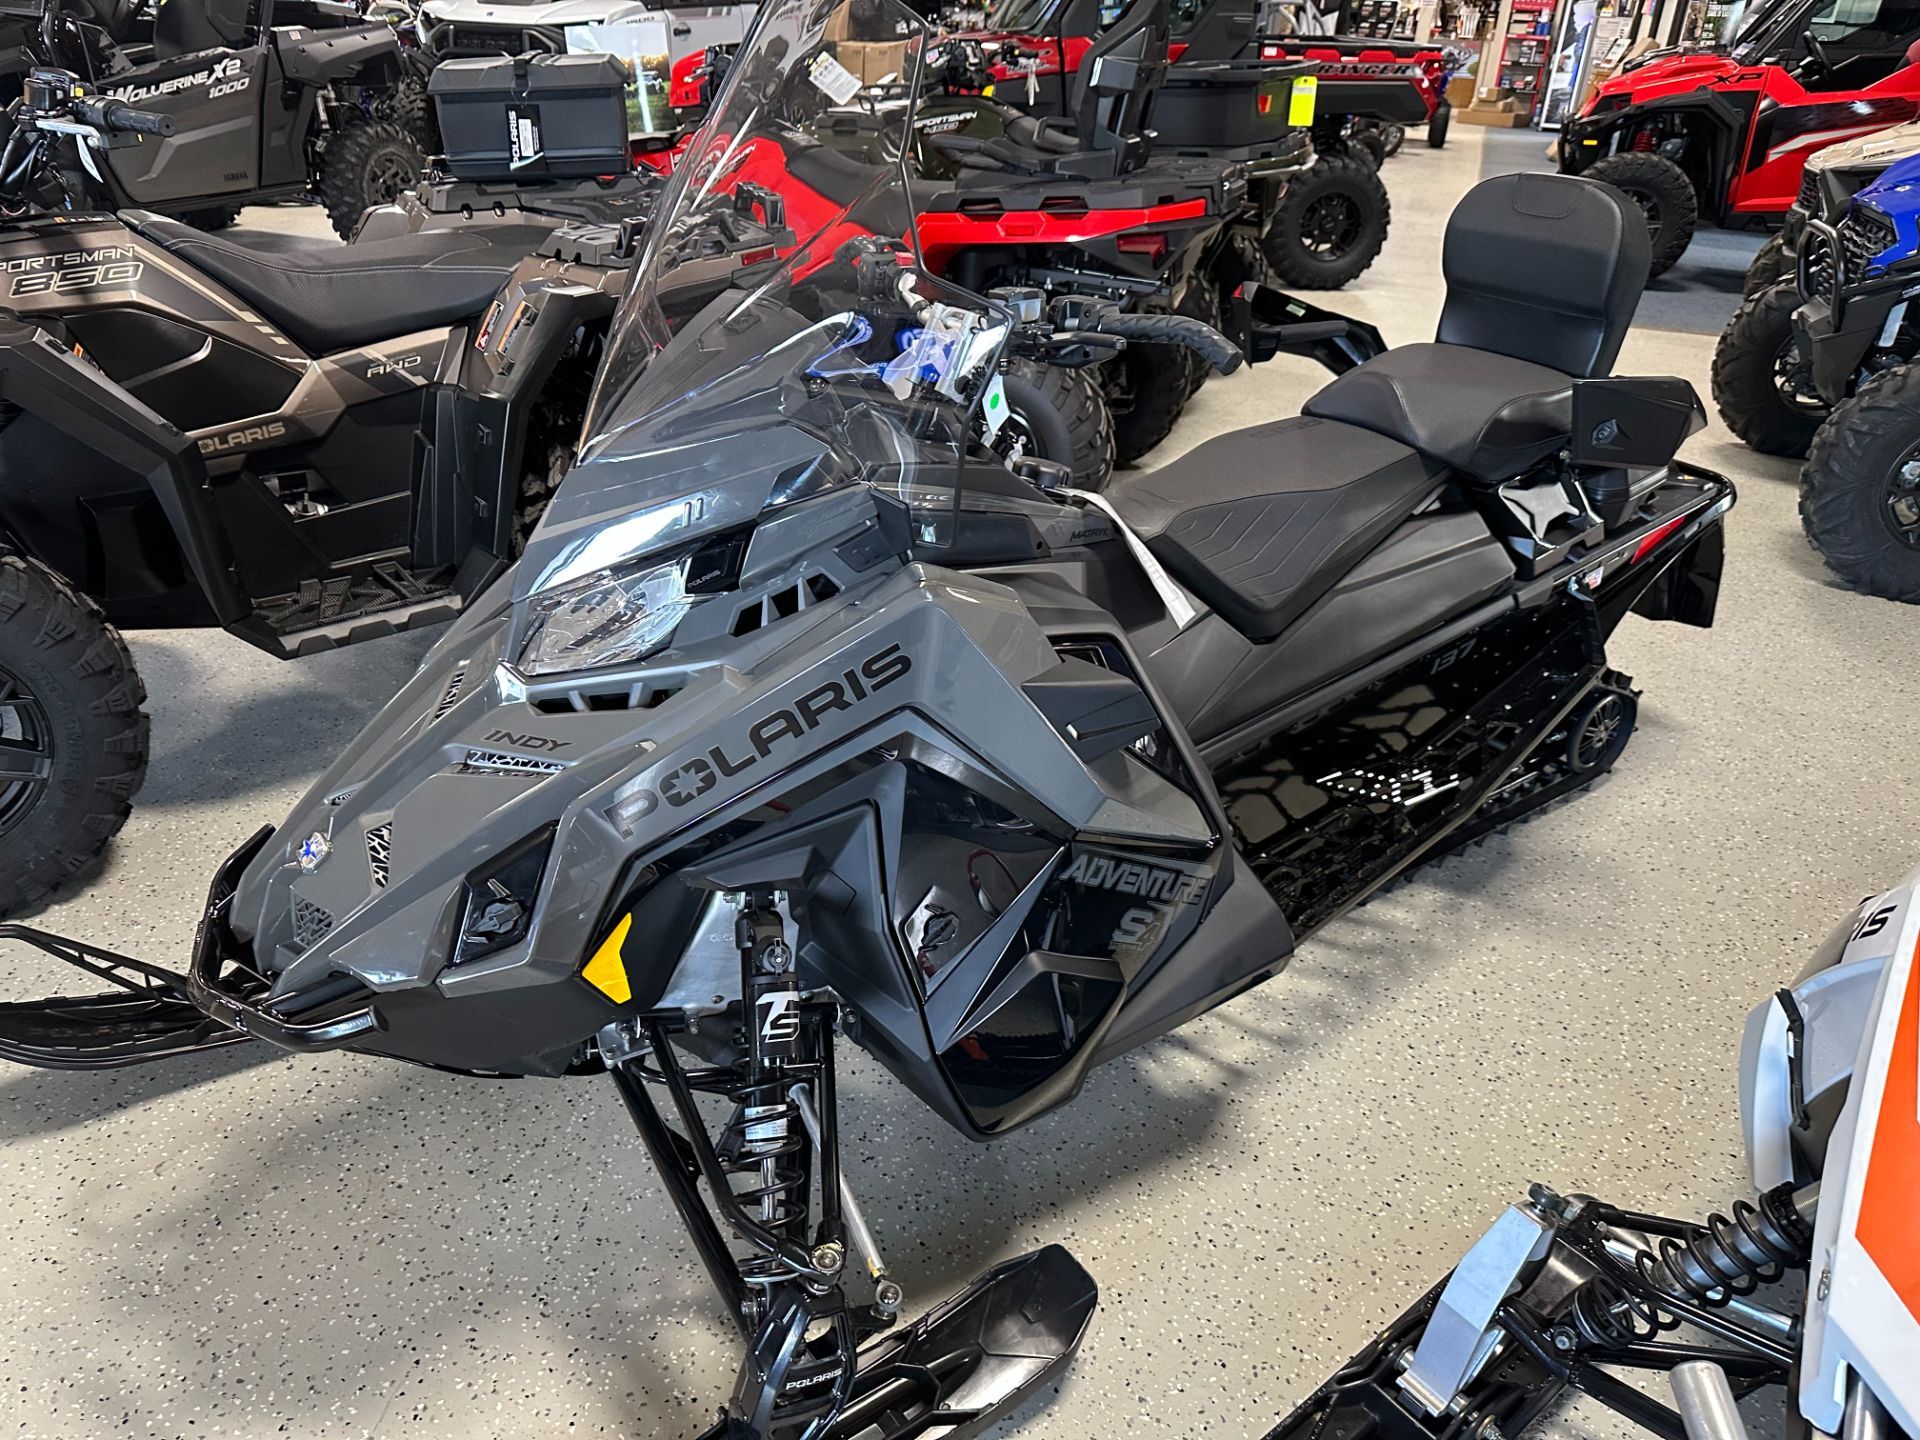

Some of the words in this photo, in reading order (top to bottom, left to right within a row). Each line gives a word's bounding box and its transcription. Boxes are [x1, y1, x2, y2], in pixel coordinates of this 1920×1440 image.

[106, 71, 209, 102] WOLVERINE
[206, 58, 241, 85] X2
[1316, 63, 1412, 75] RANGER
[1708, 72, 1765, 87] XP
[208, 77, 250, 98] 1000
[508, 110, 520, 164] POLARIS
[8, 261, 144, 299] 850
[366, 355, 422, 378] AWD
[687, 569, 721, 588] POLARIS
[482, 729, 573, 752] INDY
[602, 642, 913, 840] POLARIS
[1058, 853, 1212, 906] ADVENTURE
[1849, 895, 1899, 942] IS
[785, 1368, 843, 1391] POLARIS
